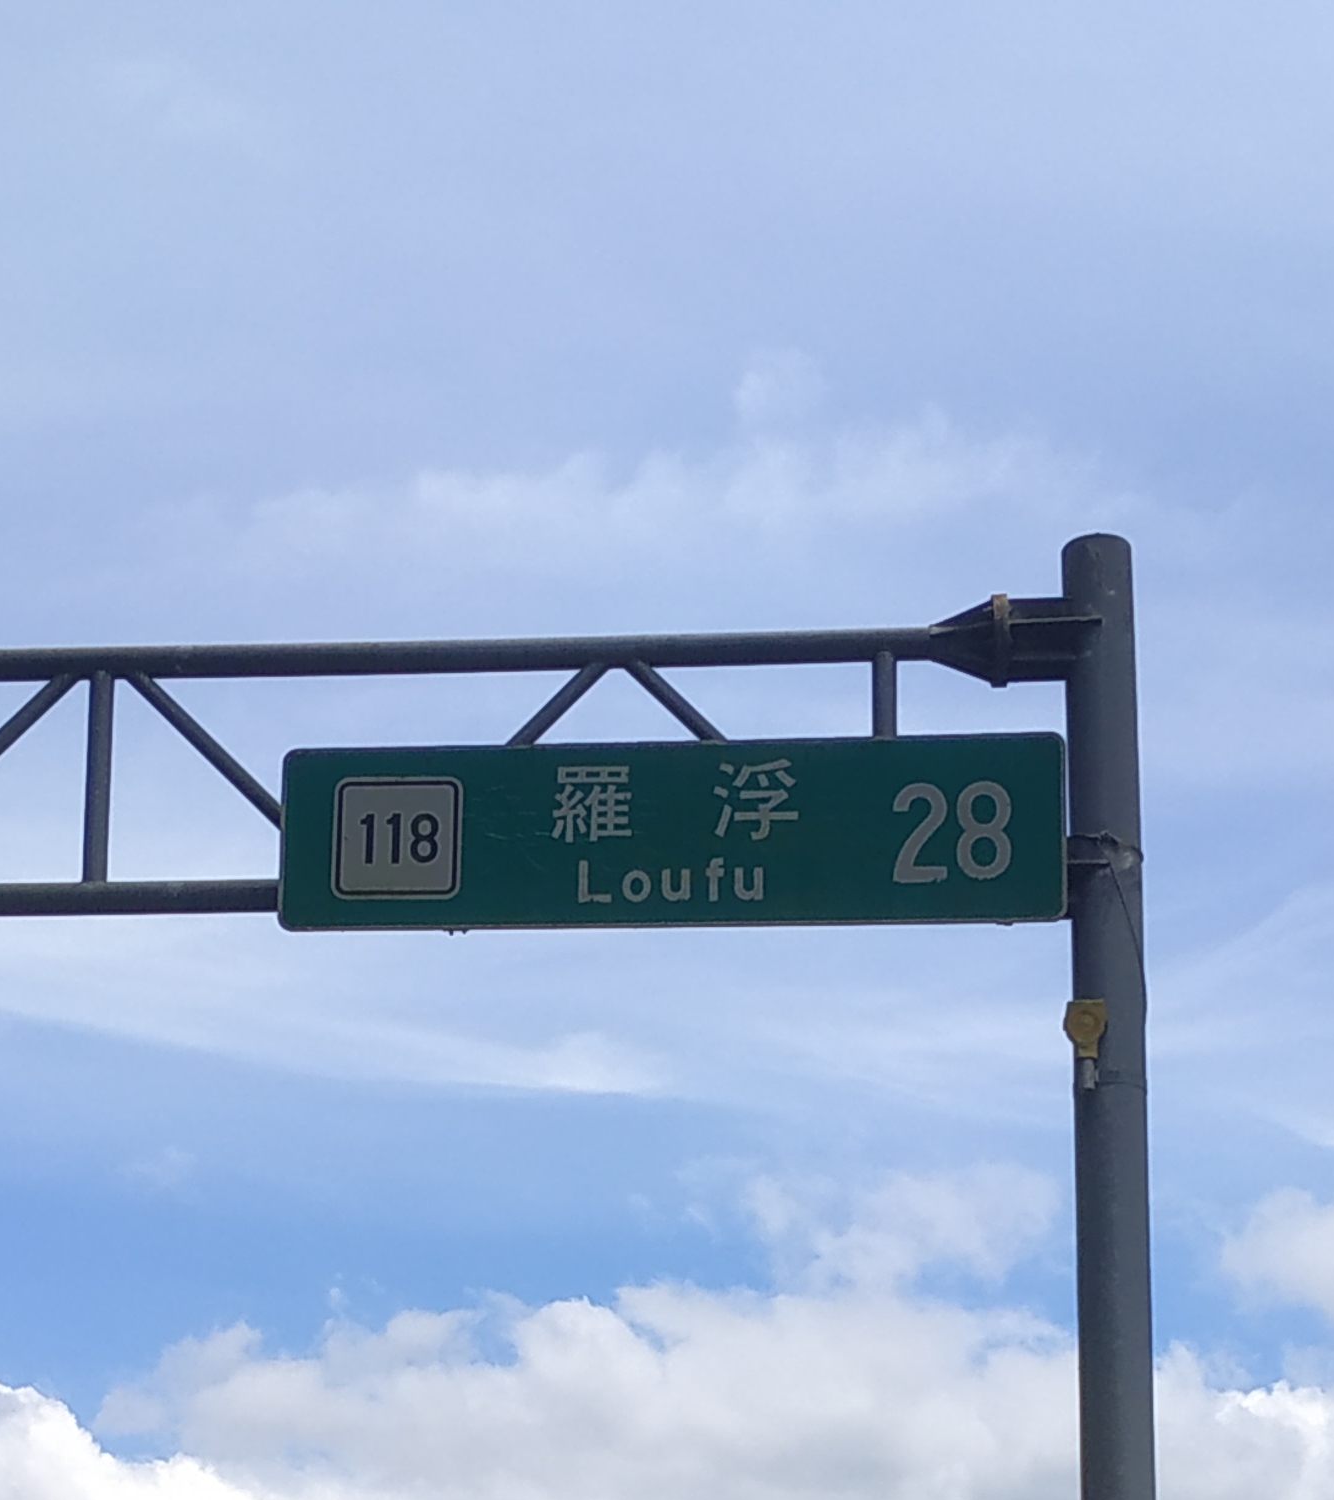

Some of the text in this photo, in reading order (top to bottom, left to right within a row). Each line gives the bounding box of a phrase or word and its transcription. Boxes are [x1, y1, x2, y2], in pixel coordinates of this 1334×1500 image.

[552, 760, 799, 844] 羅浮
[892, 781, 1013, 885] 28
[358, 813, 440, 865] 118
[578, 861, 765, 905] Loufu
